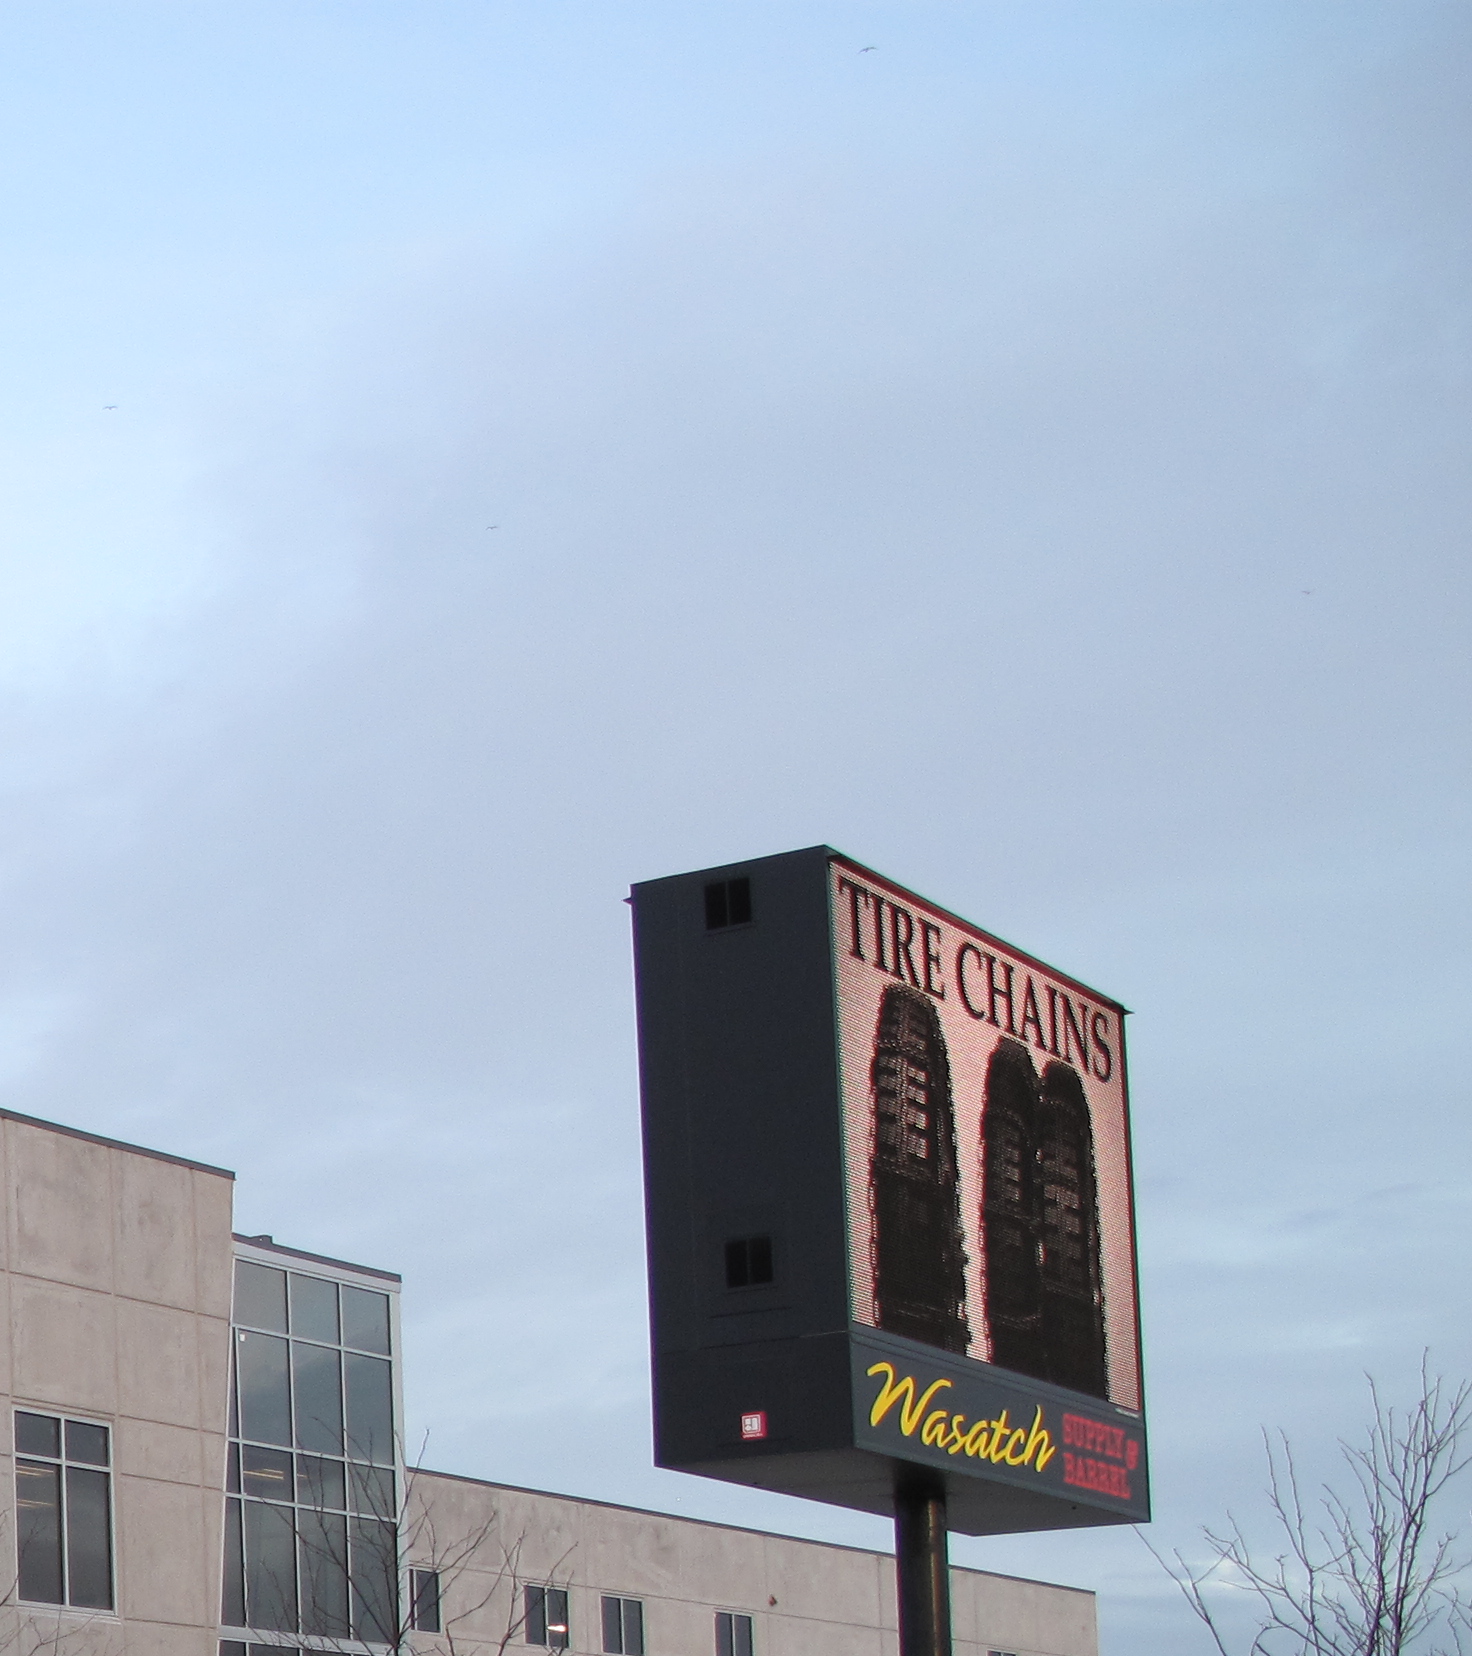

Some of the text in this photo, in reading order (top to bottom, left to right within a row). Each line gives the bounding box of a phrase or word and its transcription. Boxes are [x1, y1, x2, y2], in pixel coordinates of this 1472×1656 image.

[838, 875, 1112, 1084] TIRE CHAINS
[867, 1361, 1056, 1474] Wasatch
